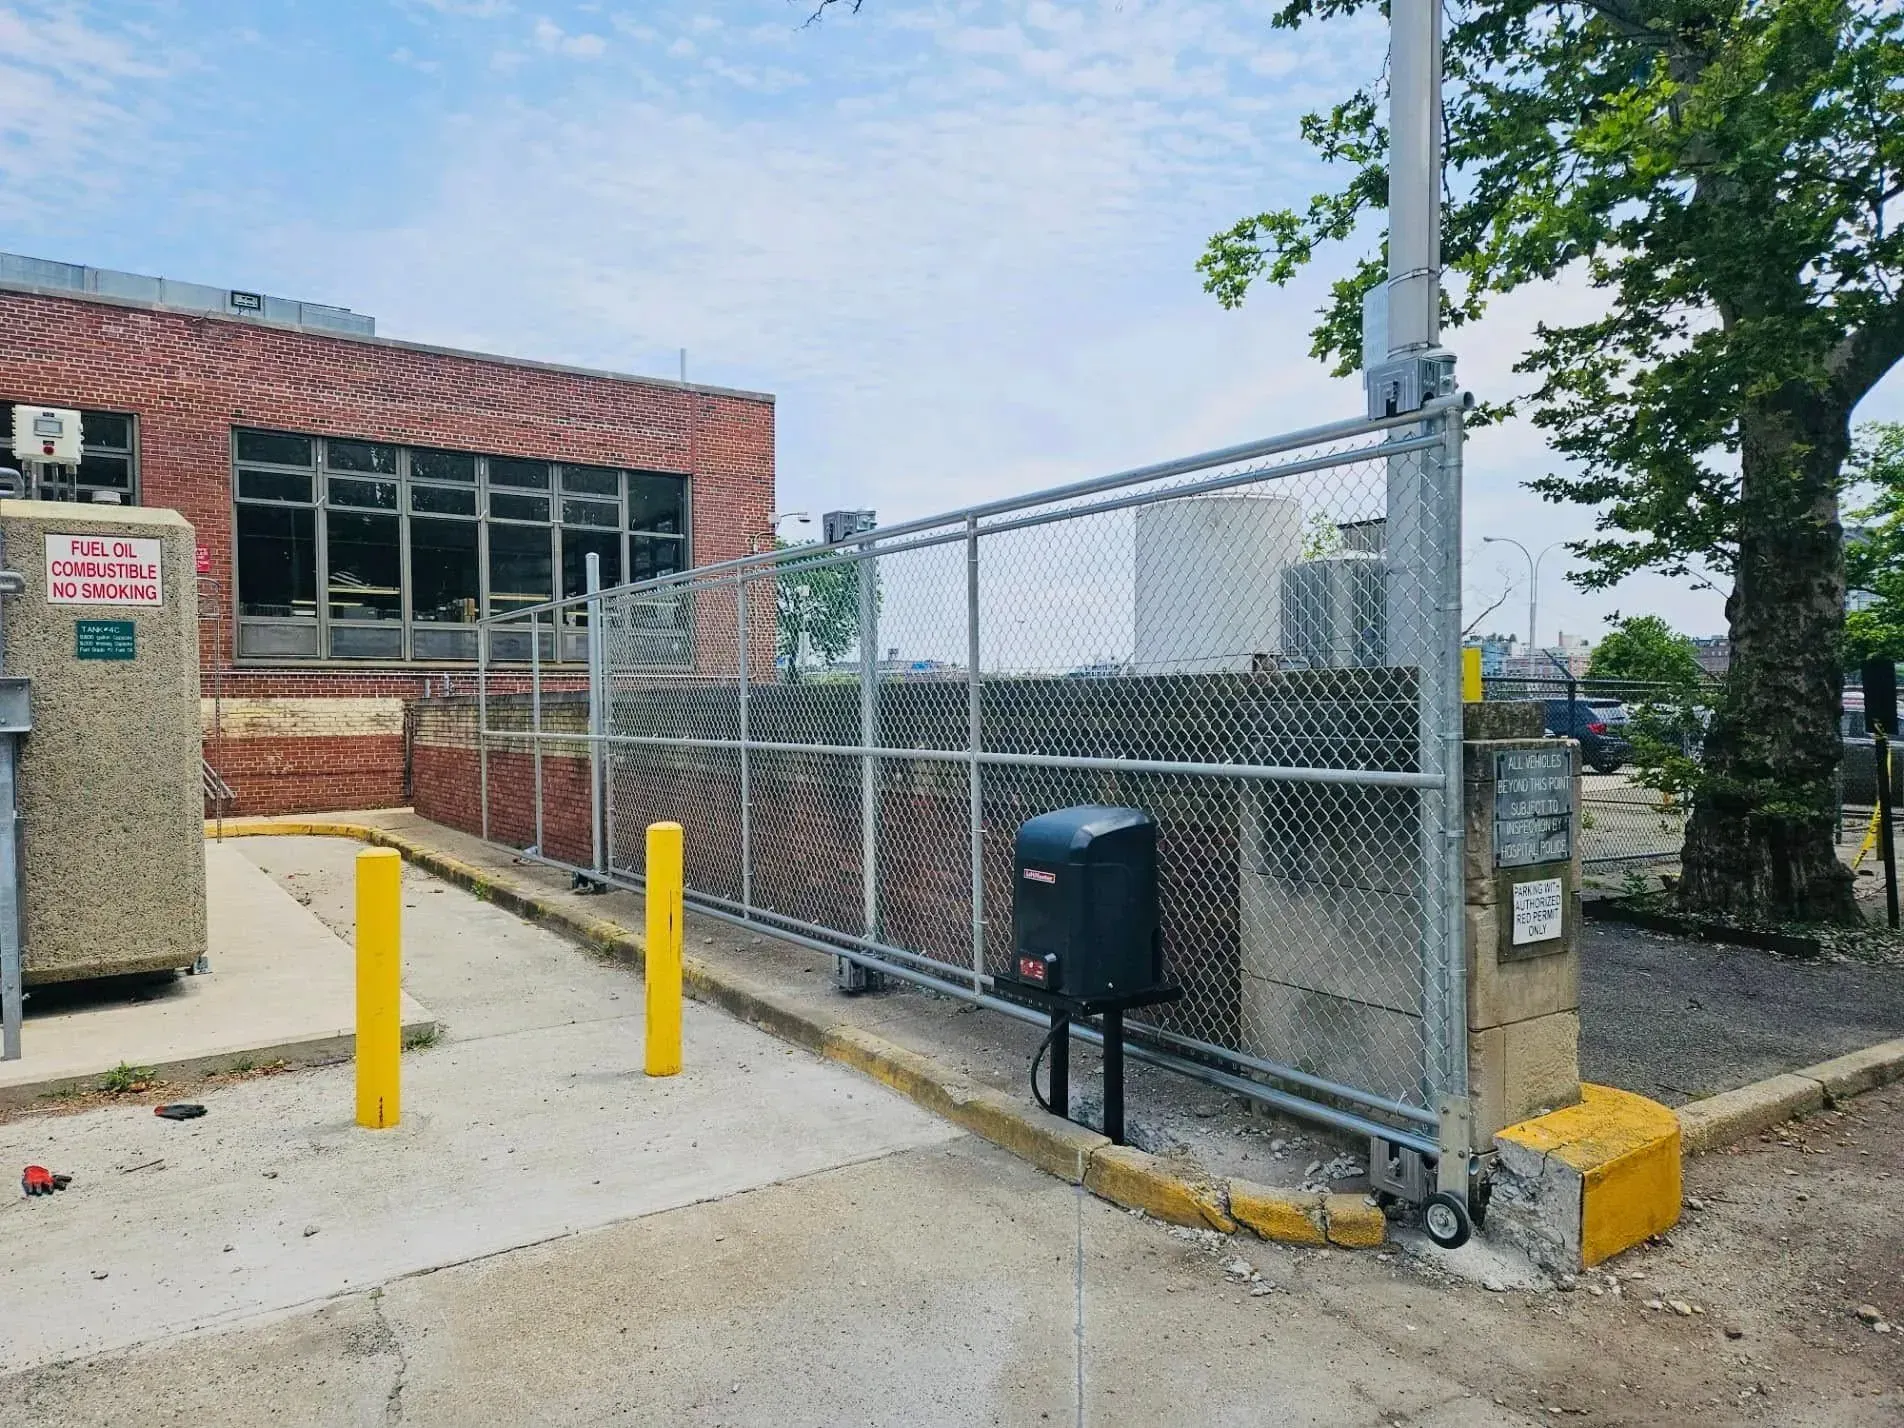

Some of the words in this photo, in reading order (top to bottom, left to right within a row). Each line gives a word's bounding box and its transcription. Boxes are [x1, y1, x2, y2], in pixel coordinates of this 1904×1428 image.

[72, 541, 109, 557] FUEL
[113, 542, 137, 558] OIL
[51, 561, 157, 579] COMBUSTIBLE
[53, 582, 77, 598] NO
[82, 583, 157, 600] SMOKING
[1508, 756, 1523, 770] ALL
[1526, 754, 1561, 769] VEHICLES
[1498, 779, 1528, 793] BEYOND
[1529, 777, 1547, 792] THIS
[1549, 776, 1570, 791] POINT
[1511, 800, 1545, 815] SUBJECT
[1548, 799, 1559, 813] TO
[1506, 818, 1551, 835] INSPECTON
[1501, 842, 1538, 859] HOSPITAL
[1541, 839, 1566, 855] POLCE
[1515, 883, 1542, 896] PARKING
[1516, 895, 1560, 911] AUTHORIZED
[1517, 912, 1531, 924] RED
[1533, 908, 1559, 921] PERMIT
[1529, 923, 1547, 936] ONLY
